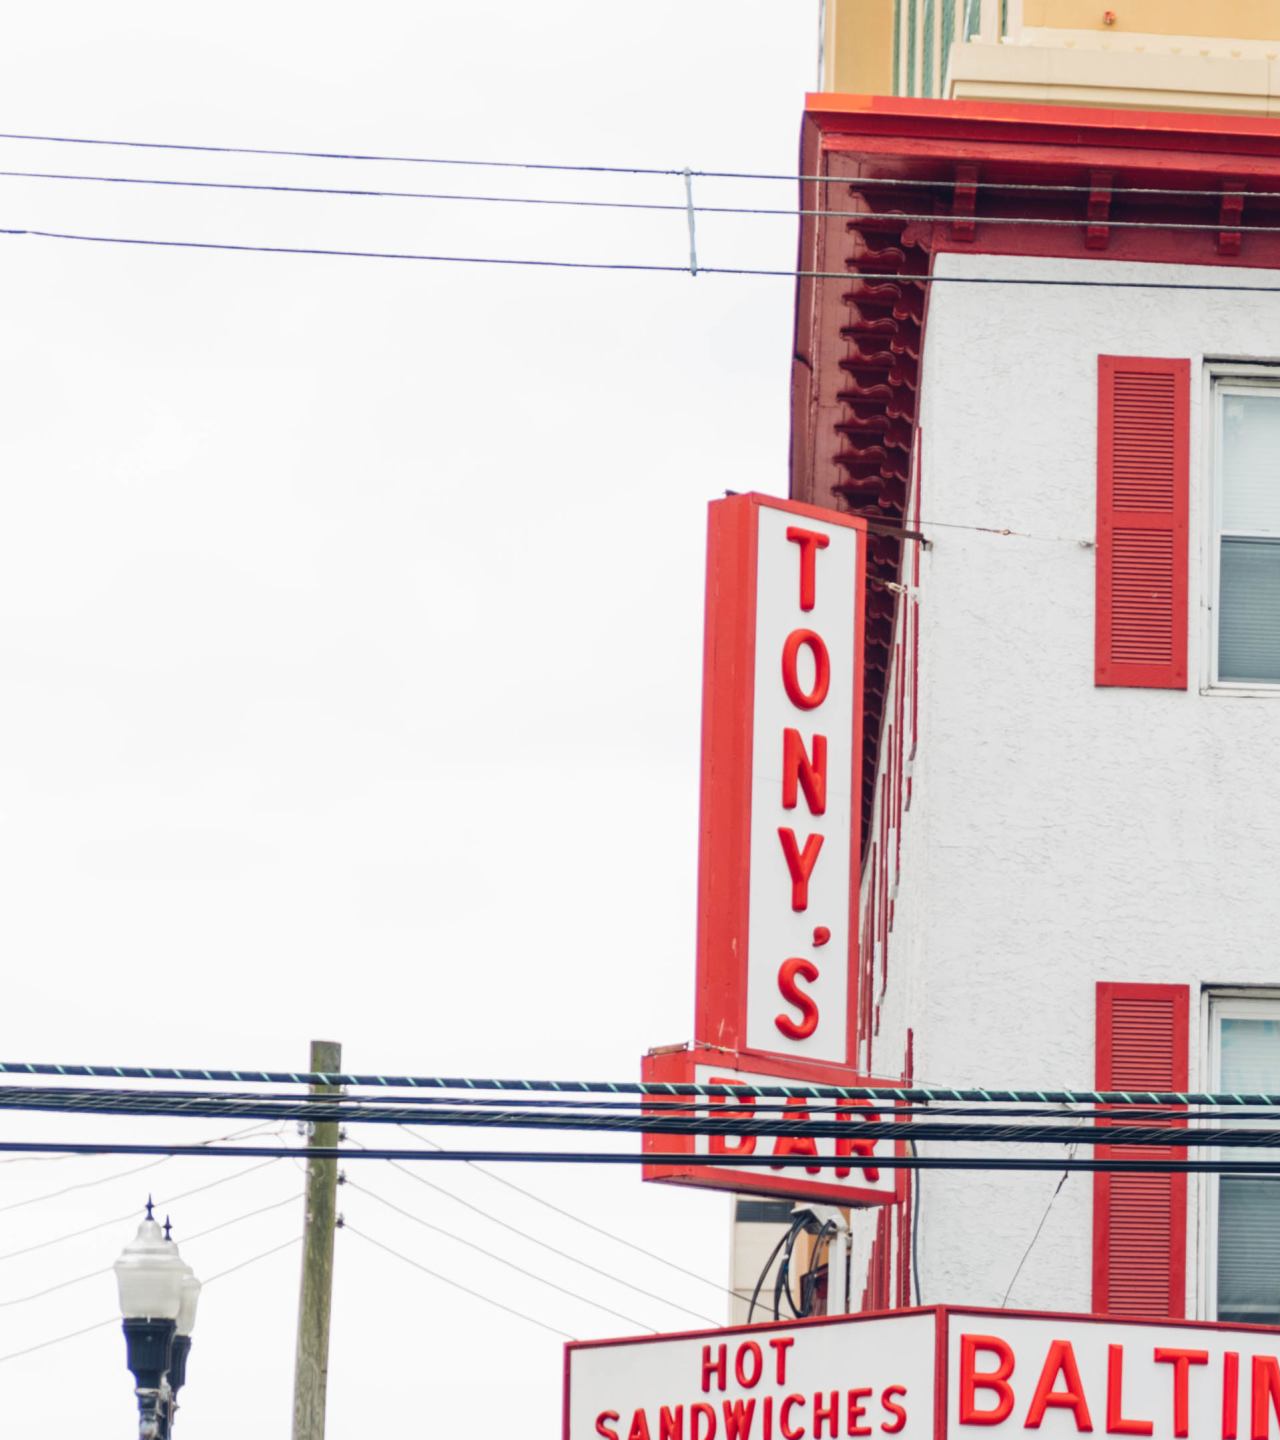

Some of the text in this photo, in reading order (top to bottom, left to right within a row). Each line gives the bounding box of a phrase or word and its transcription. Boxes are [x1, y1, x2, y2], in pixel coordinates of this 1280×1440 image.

[775, 526, 830, 1040] TONY'S
[708, 1077, 881, 1182] BAR
[701, 1337, 795, 1392] HOT
